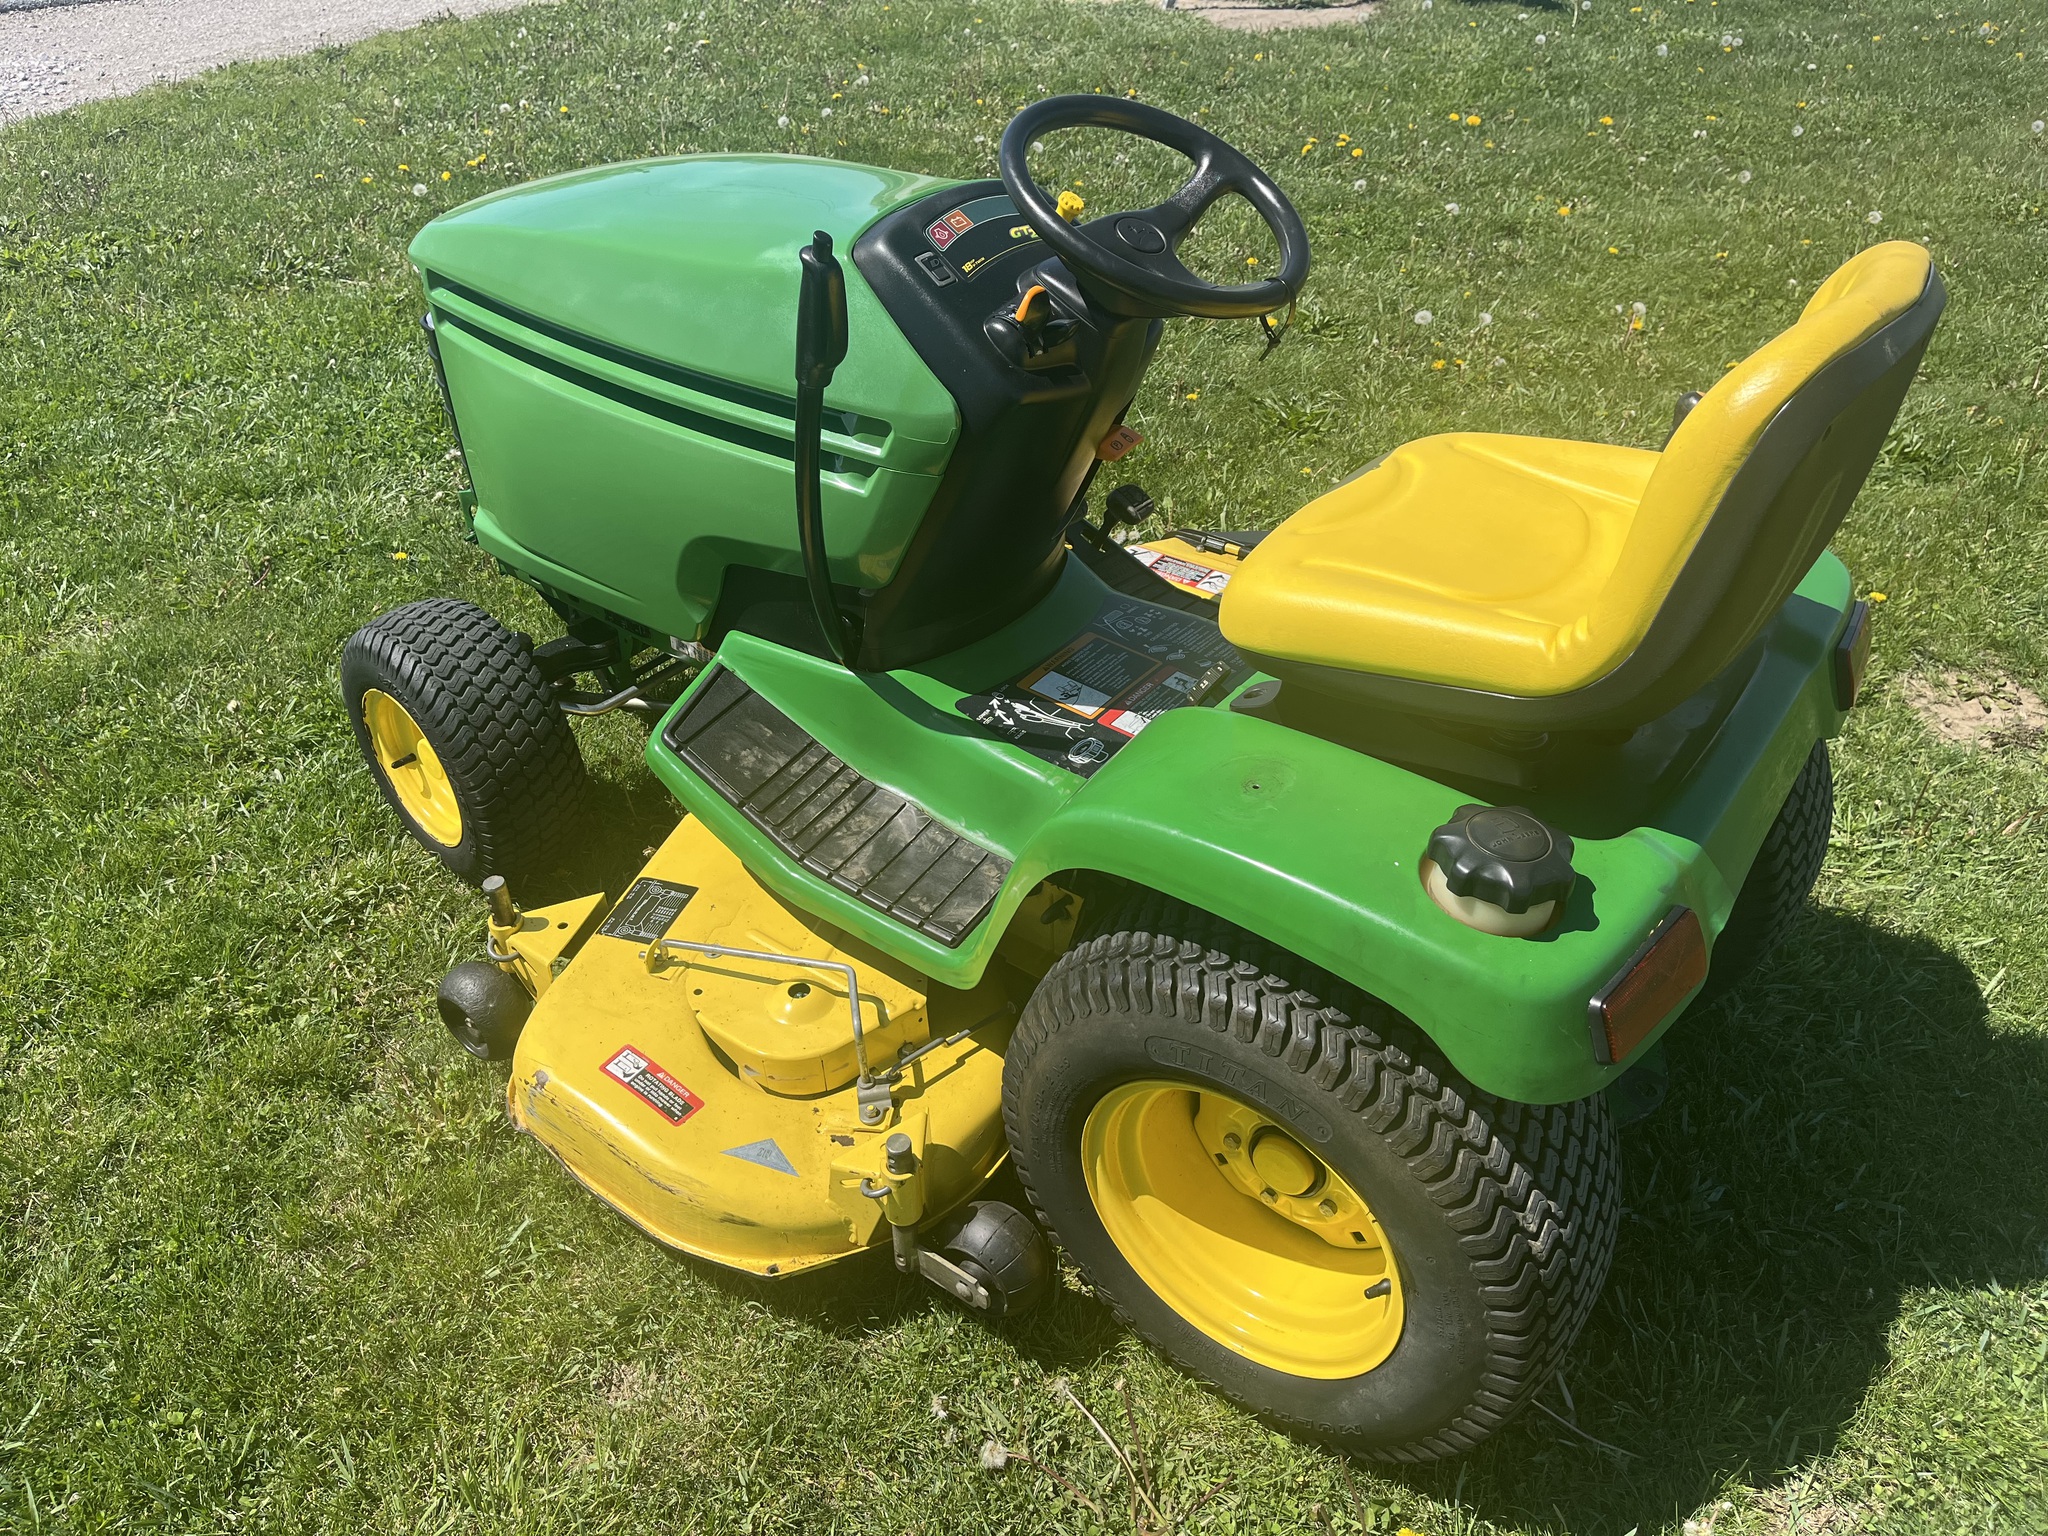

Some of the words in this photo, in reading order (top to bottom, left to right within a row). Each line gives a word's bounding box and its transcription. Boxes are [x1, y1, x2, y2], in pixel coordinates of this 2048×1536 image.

[962, 261, 972, 273] 18
[1131, 682, 1154, 703] DANGER
[1492, 836, 1513, 848] JOHN
[630, 1081, 643, 1092] engine
[642, 1078, 651, 1086] not
[649, 1083, 658, 1092] put
[657, 1090, 669, 1100] hands
[646, 1074, 668, 1092] ROTATING
[668, 1091, 685, 1105] BLADE
[664, 1077, 690, 1097] DANGER
[1169, 1043, 1309, 1121] TITAN
[649, 1089, 658, 1097] into
[657, 1096, 670, 1107] mower
[1263, 1405, 1363, 1436] MULTI
